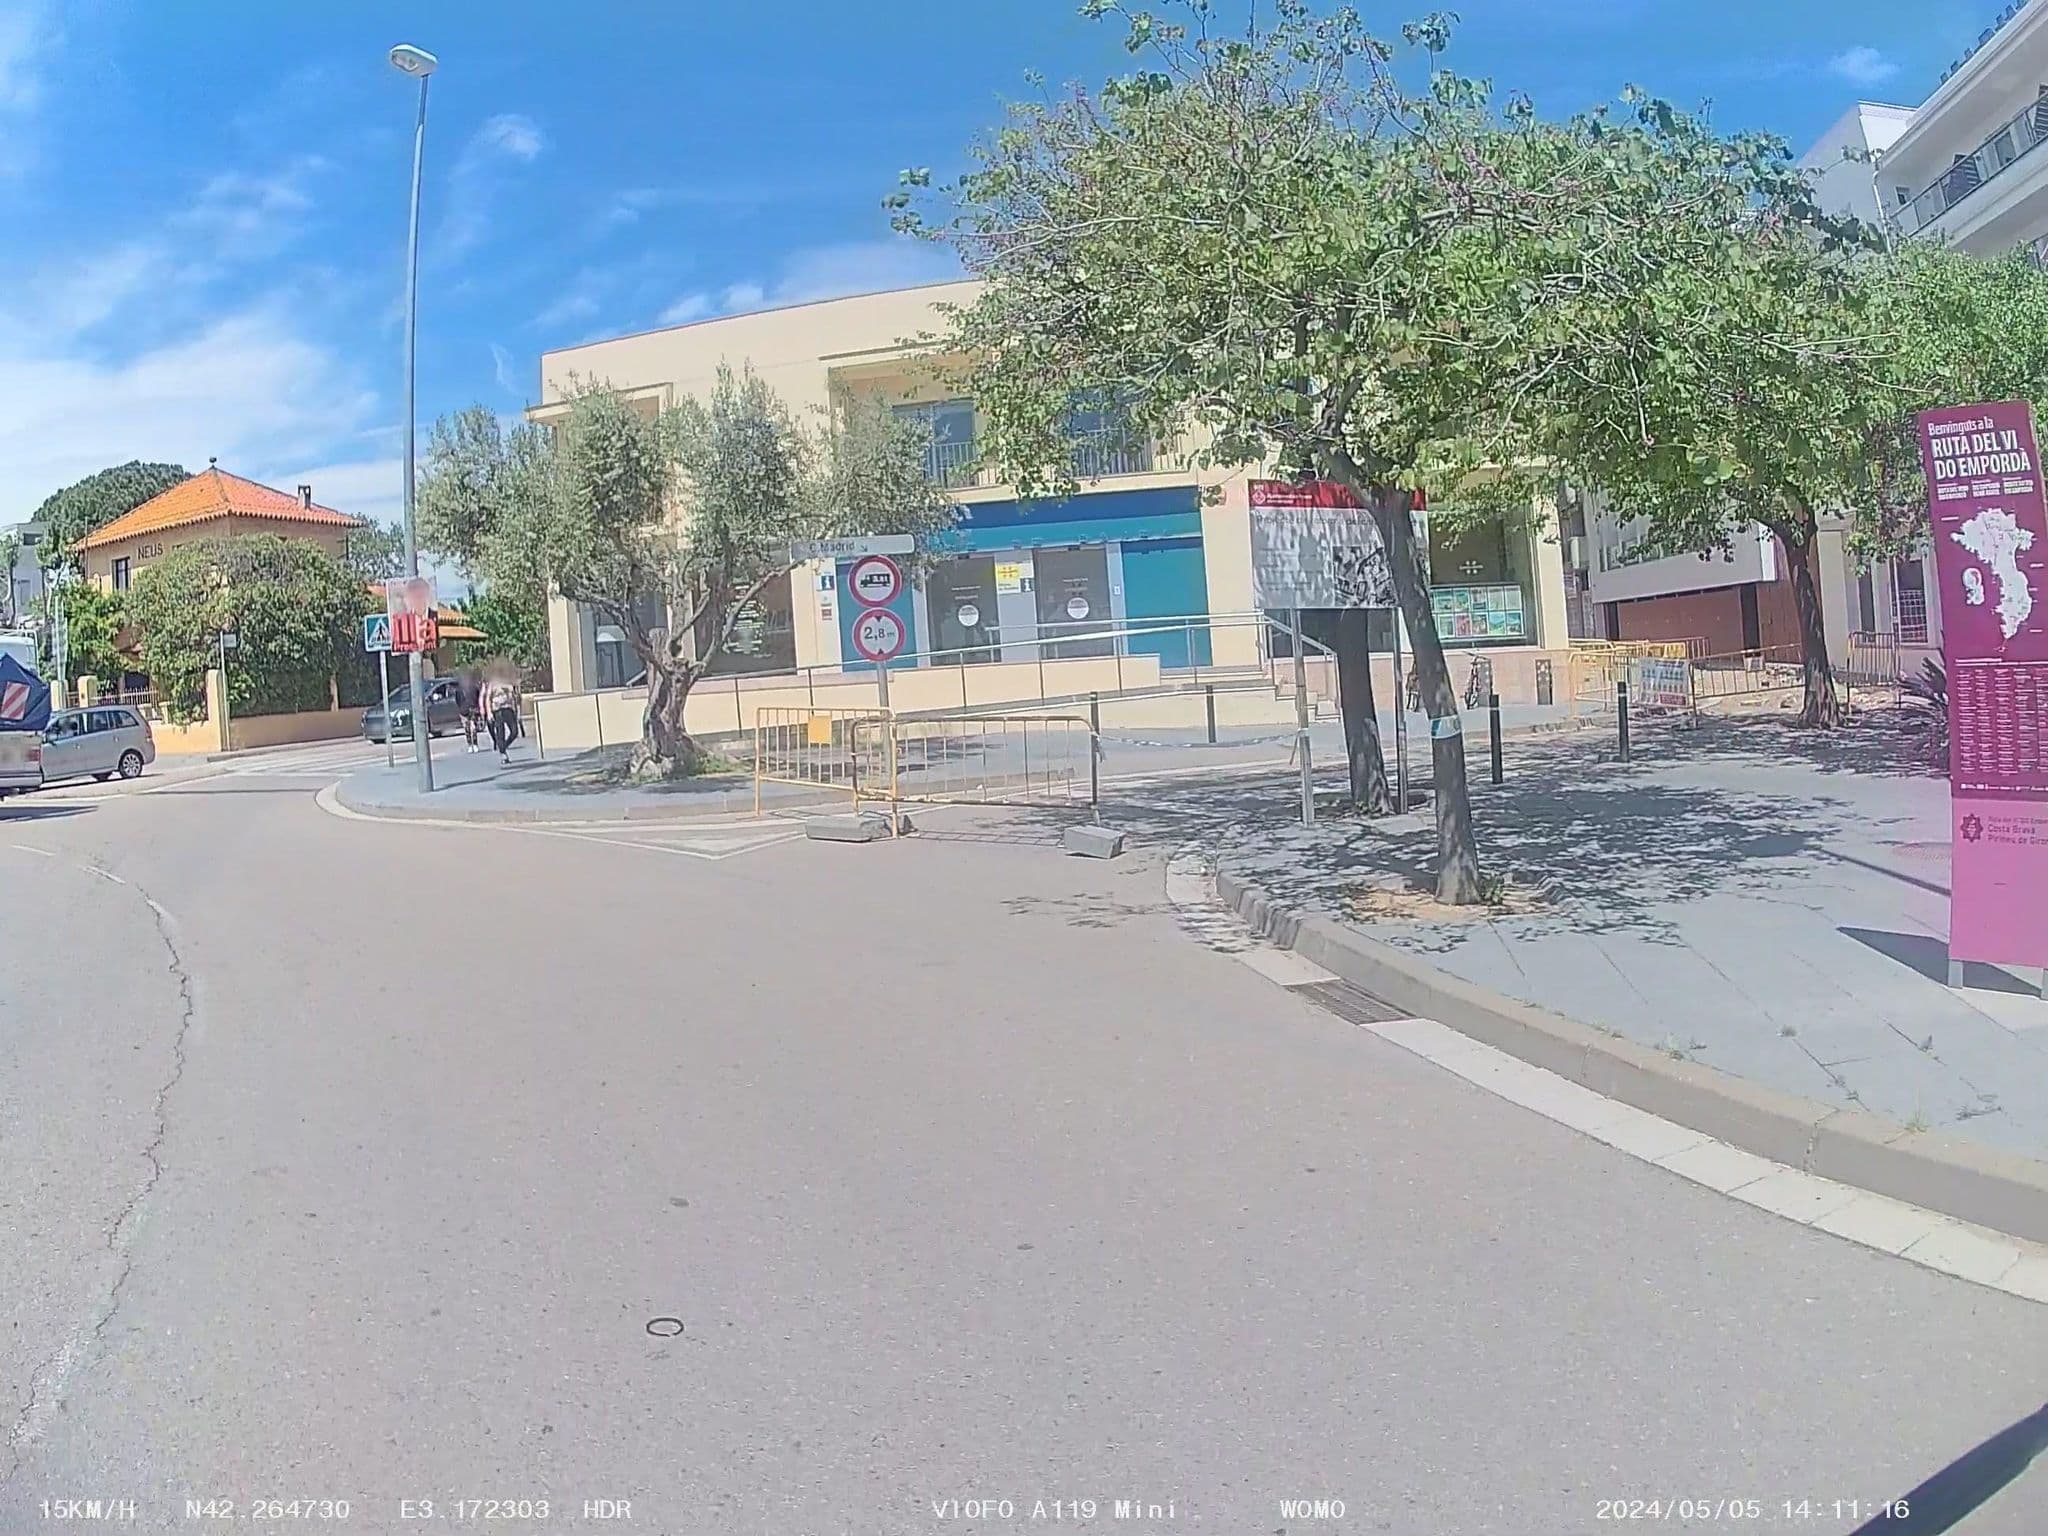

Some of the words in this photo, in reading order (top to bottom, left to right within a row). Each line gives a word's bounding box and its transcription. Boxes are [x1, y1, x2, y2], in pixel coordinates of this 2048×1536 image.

[1928, 420, 1977, 435] Benvinguts
[1977, 420, 1984, 429] a
[1983, 416, 1994, 428] la
[1931, 436, 1971, 457] RUTA
[1971, 432, 2001, 453] DEL
[2000, 430, 2018, 450] VI
[1934, 459, 1957, 480] DO
[1957, 448, 2031, 477] EMPORDÀ
[138, 543, 163, 559] NEUS
